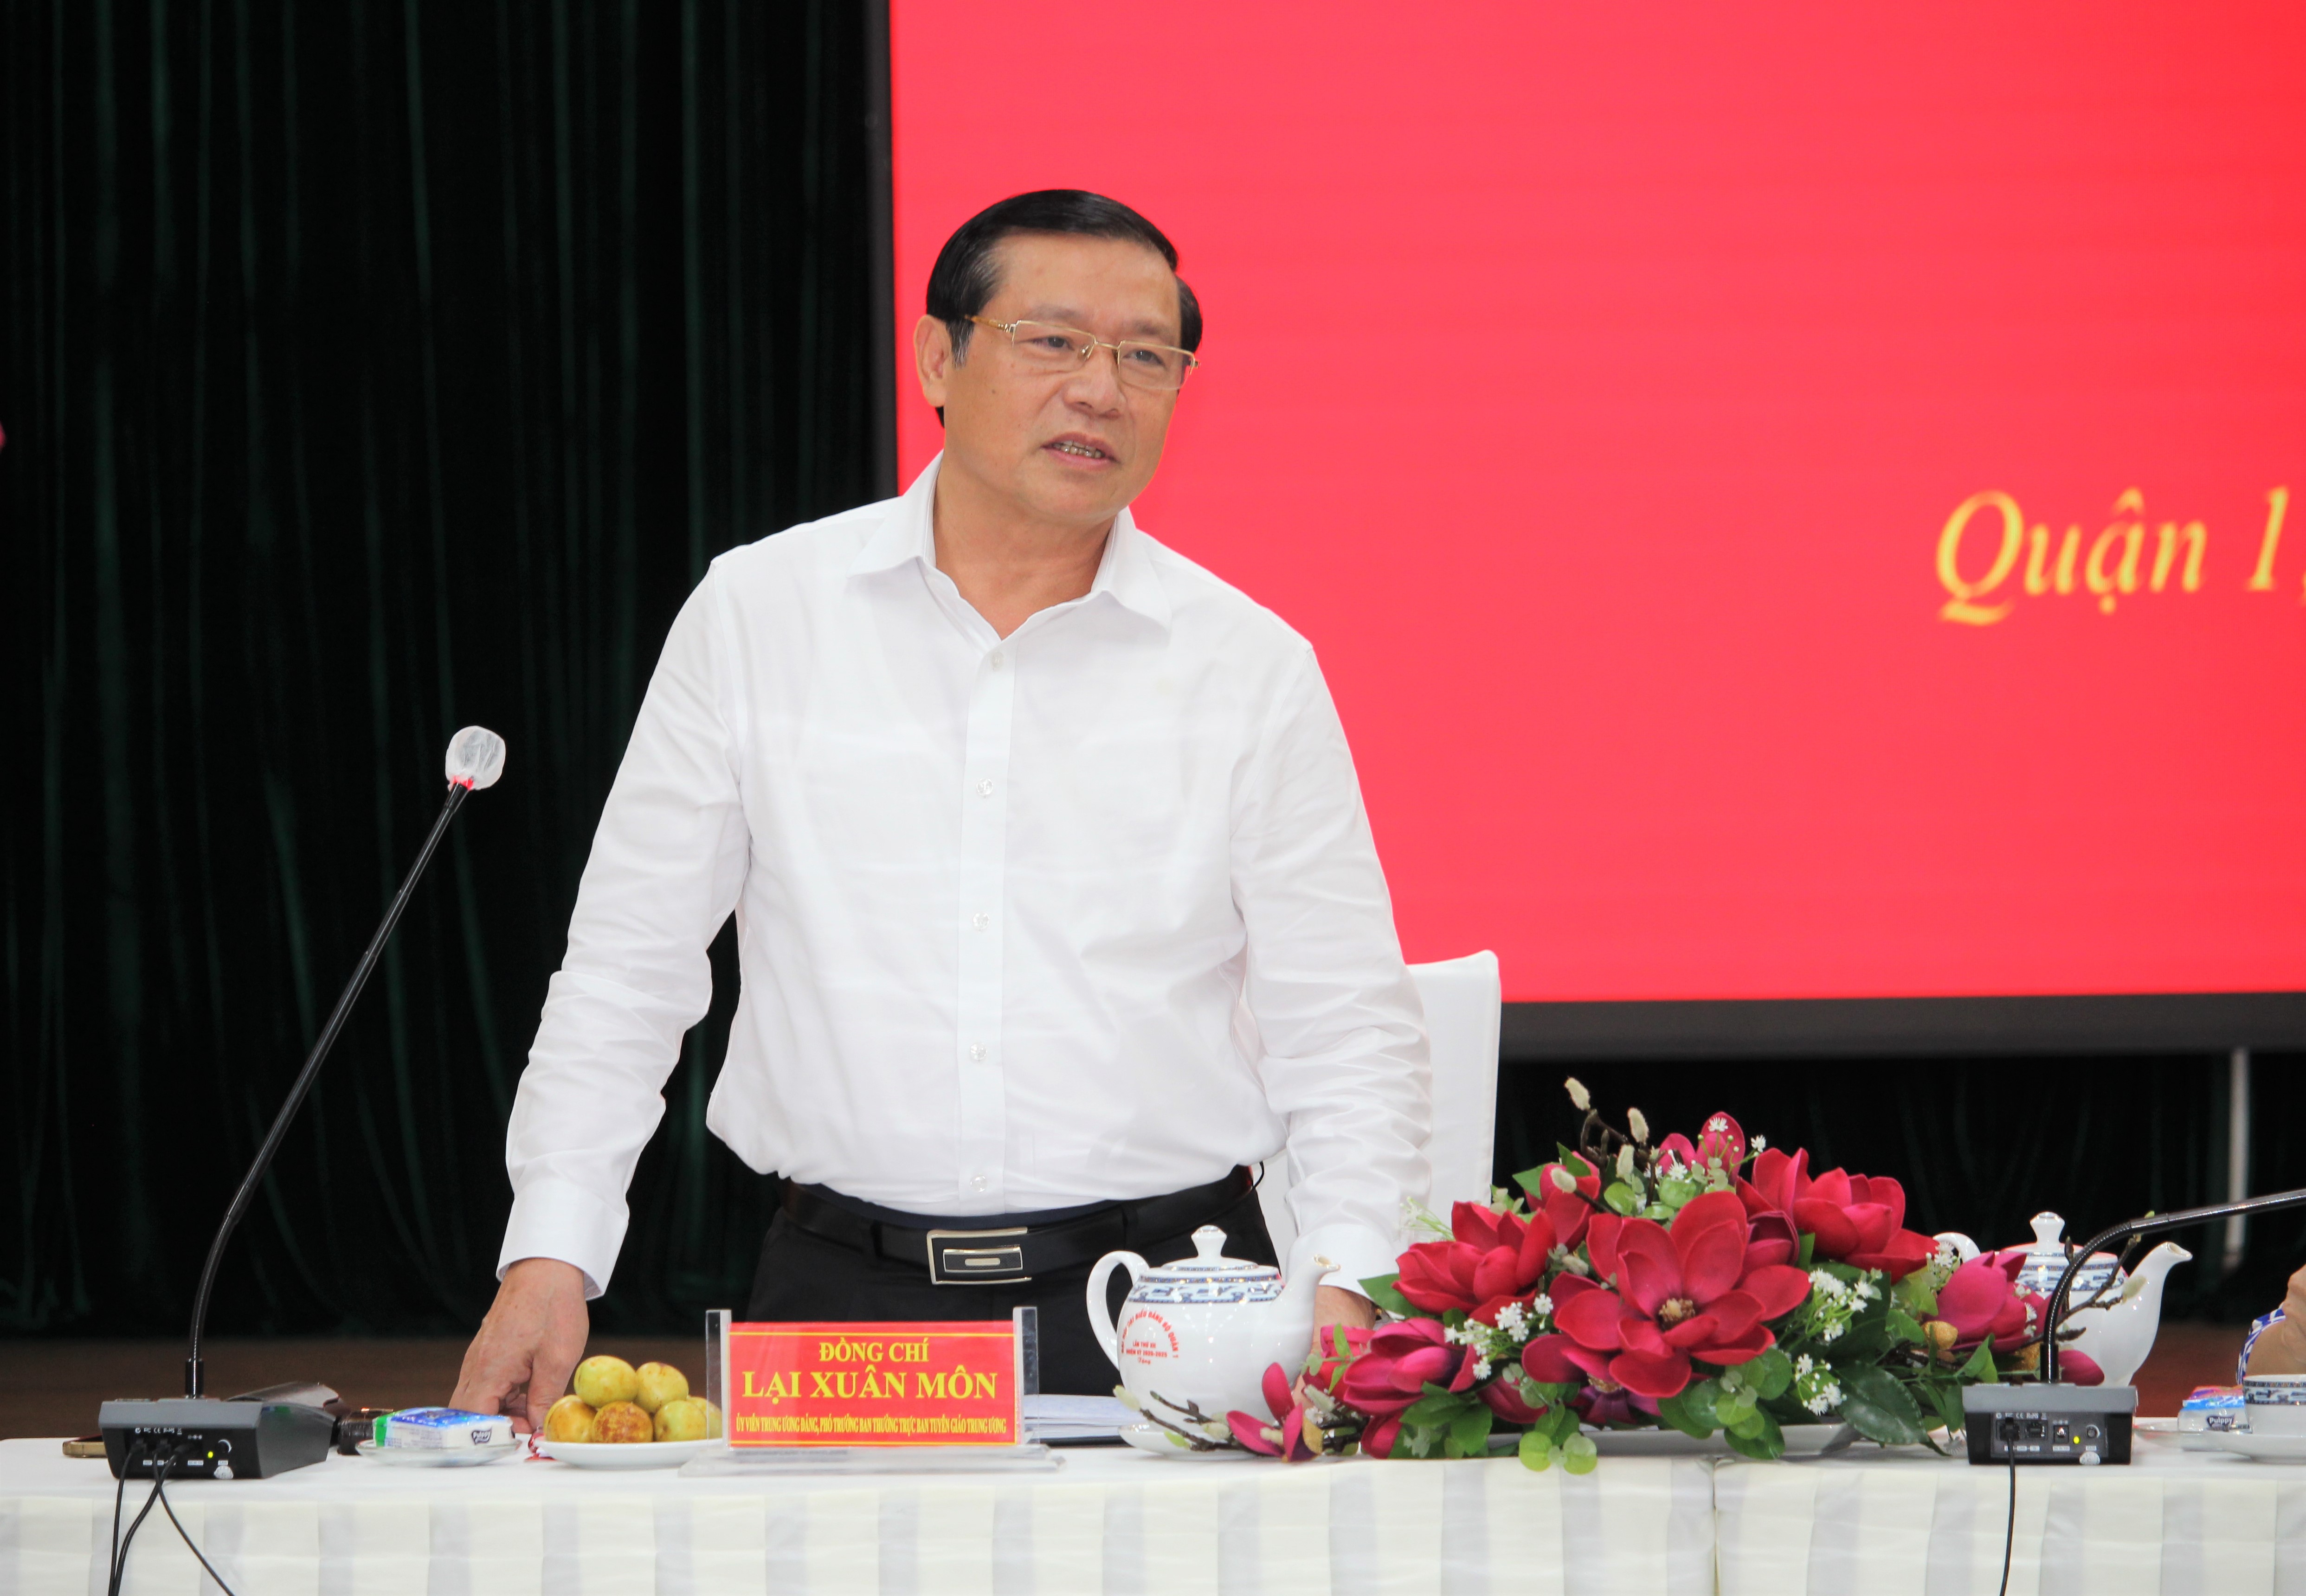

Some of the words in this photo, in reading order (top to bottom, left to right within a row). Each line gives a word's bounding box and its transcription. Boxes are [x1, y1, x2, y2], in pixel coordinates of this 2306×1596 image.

[1935, 486, 2209, 627] Quận
[819, 1337, 883, 1362] ĐỒNG
[889, 1337, 929, 1362] CHÍ
[742, 1371, 801, 1404] LẠI
[810, 1364, 907, 1399] XUÂN
[915, 1364, 998, 1399] MÔN
[745, 1412, 760, 1432] VIÊN
[760, 1416, 782, 1433] TRUNG
[782, 1415, 800, 1433] ƯƠNG
[820, 1413, 832, 1433] PHÓ
[859, 1417, 872, 1433] BAN
[872, 1413, 898, 1433] THƯỜNG
[899, 1415, 916, 1436] TRỰC
[916, 1418, 929, 1433] BAN
[929, 1414, 950, 1434] TUYÊN
[951, 1414, 966, 1434] GIÁO
[966, 1417, 988, 1434] TRUNG
[988, 1416, 1006, 1434] ƯƠNG
[2209, 1416, 2233, 1426] Pulppy
[473, 1431, 491, 1440] Pulppy
